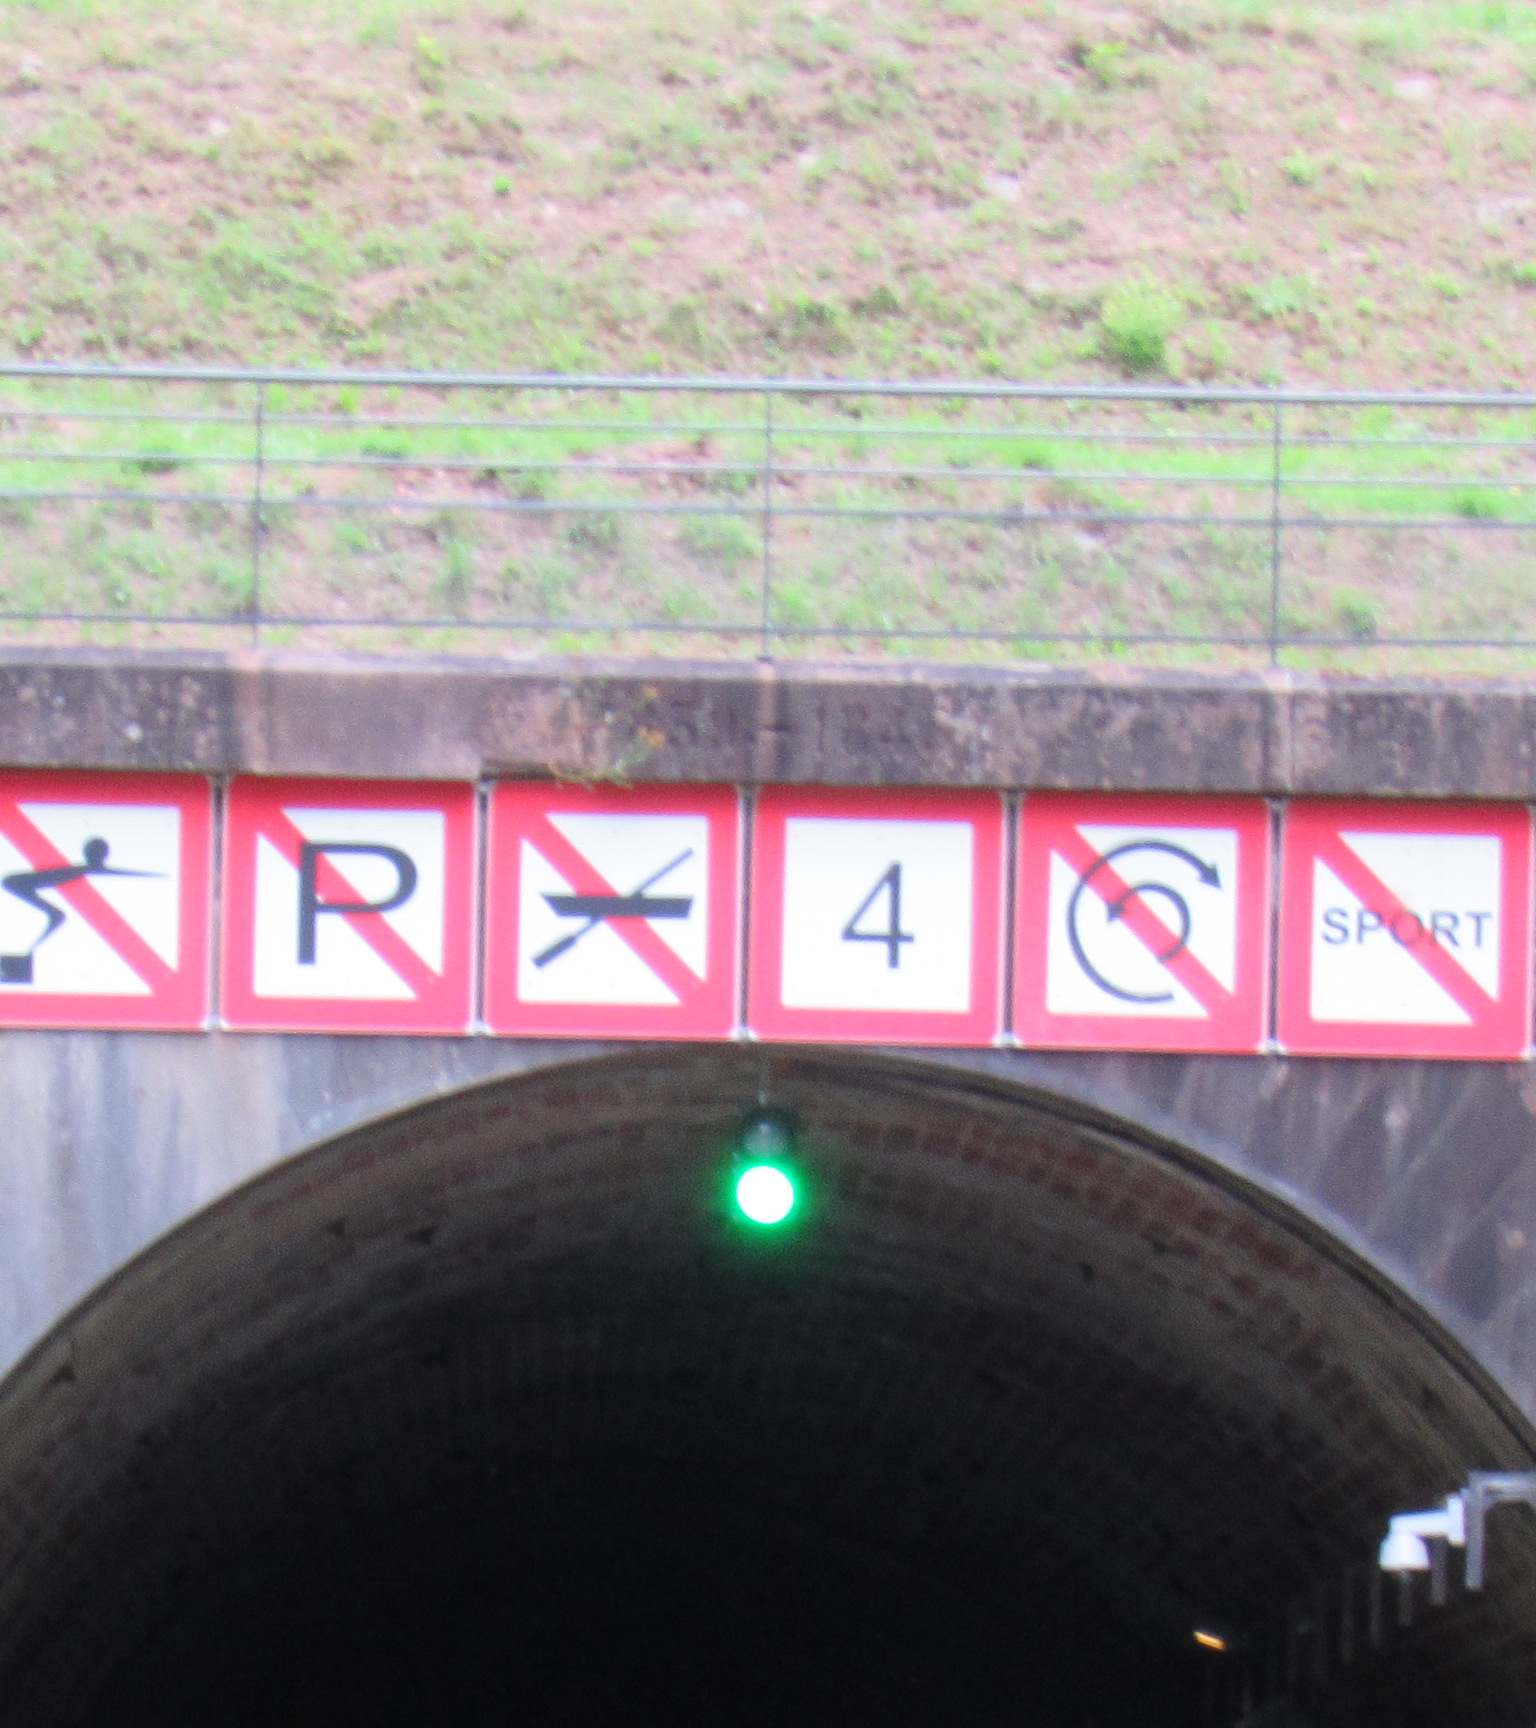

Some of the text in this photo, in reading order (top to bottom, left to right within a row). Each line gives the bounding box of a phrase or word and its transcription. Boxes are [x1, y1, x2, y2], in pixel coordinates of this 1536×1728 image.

[297, 841, 417, 965] P
[841, 861, 914, 968] 4
[1321, 907, 1494, 948] SPORT
